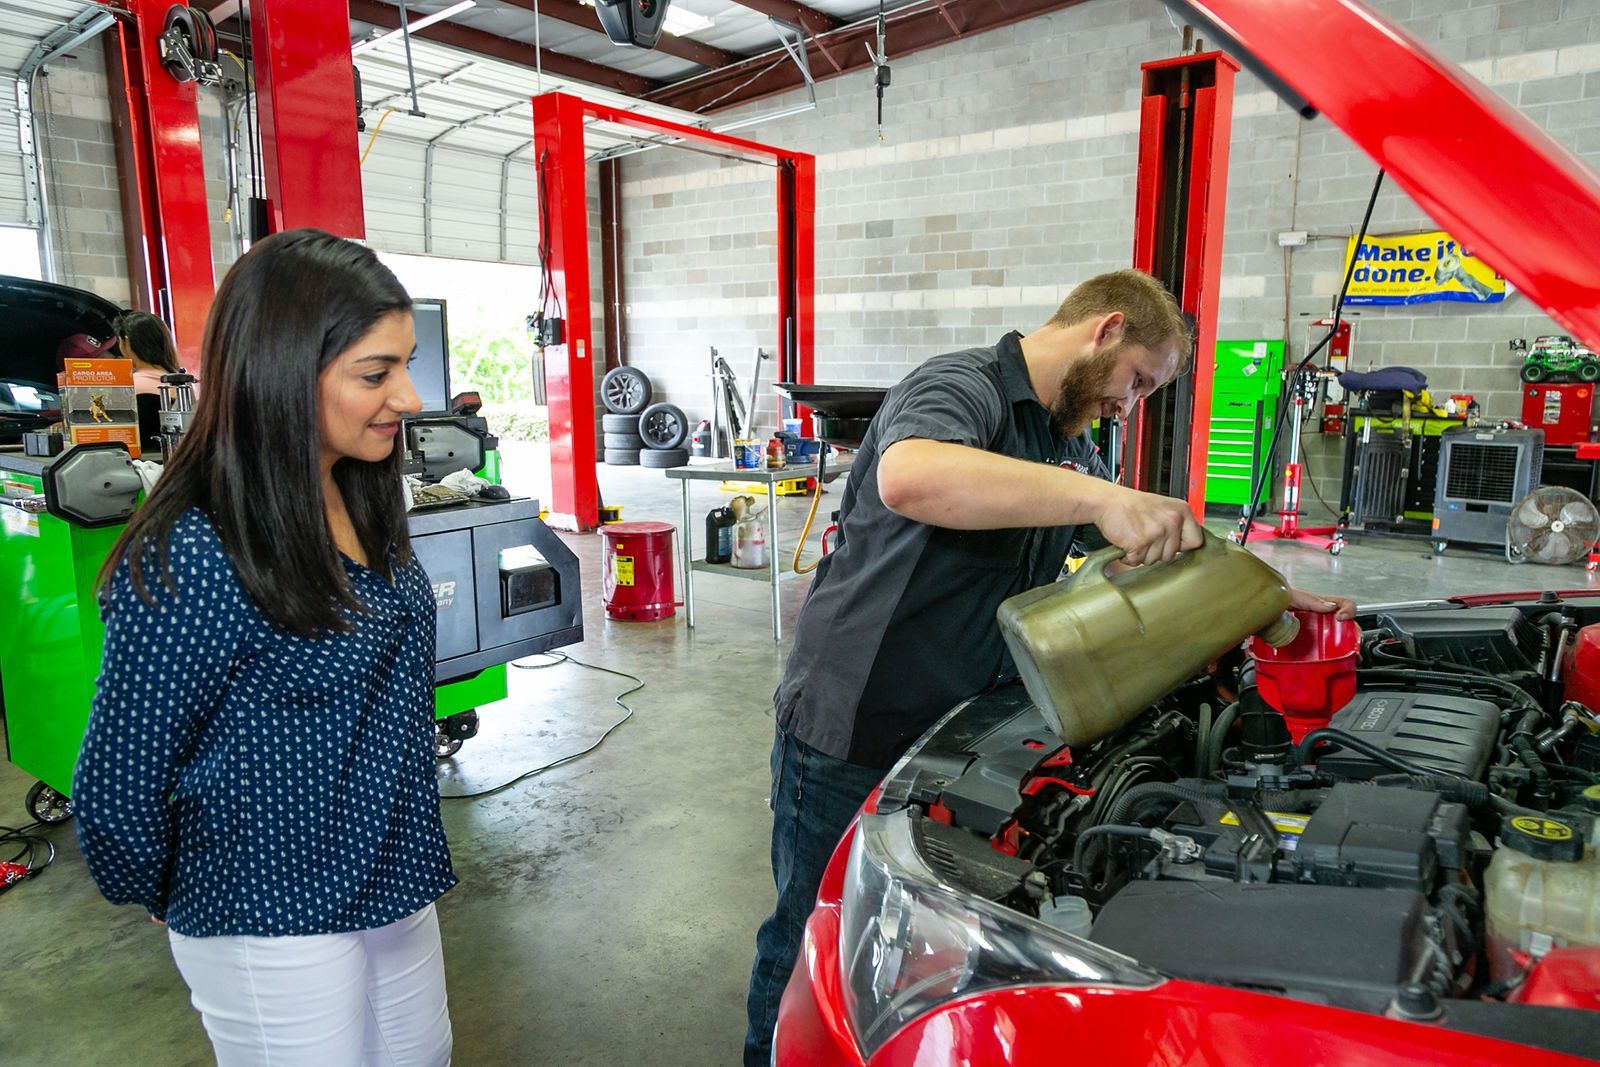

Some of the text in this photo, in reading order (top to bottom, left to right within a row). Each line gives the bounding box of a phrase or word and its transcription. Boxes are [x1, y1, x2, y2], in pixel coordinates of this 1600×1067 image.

[1356, 243, 1432, 262] Make
[1353, 264, 1431, 283] done.
[431, 581, 456, 598] ER
